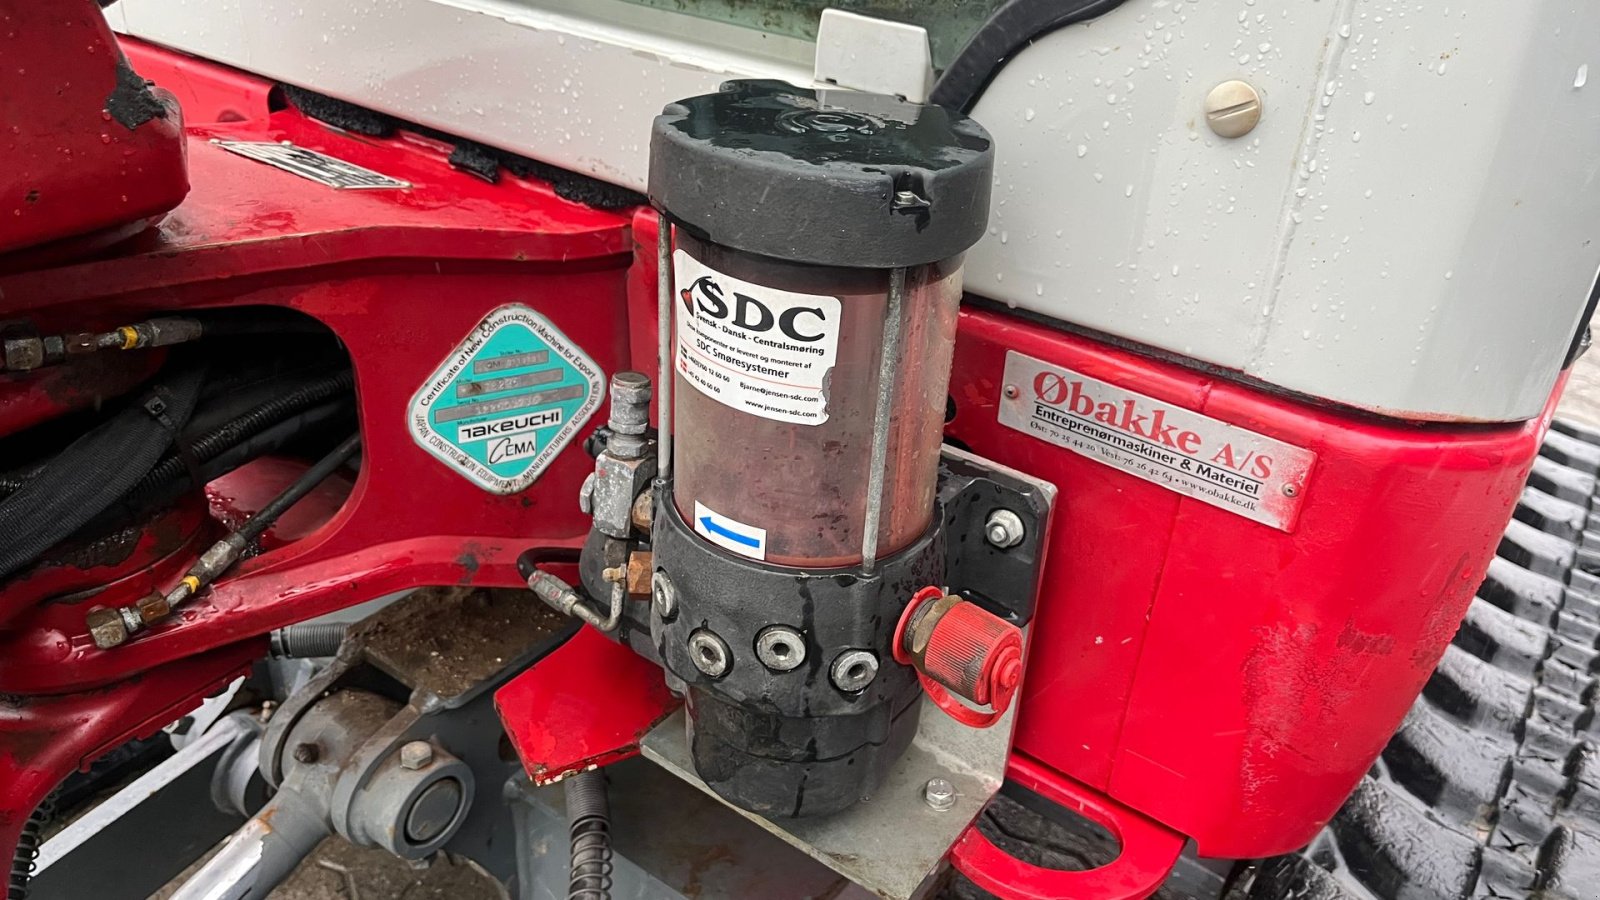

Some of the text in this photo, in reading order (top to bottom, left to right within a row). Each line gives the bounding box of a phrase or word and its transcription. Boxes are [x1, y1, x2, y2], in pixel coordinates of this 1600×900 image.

[697, 276, 826, 342] SDC
[696, 311, 717, 329] Svensk
[722, 325, 747, 340] Dansk
[753, 336, 825, 356] Centralsmøring
[696, 327, 728, 349] komponenter
[736, 348, 759, 359] leveret
[760, 355, 769, 363] og
[770, 357, 802, 368] monteret
[421, 365, 460, 406] Certificate
[458, 354, 468, 366] of
[464, 337, 483, 357] New
[482, 314, 538, 338] Construction
[537, 325, 565, 352] Machine
[563, 348, 575, 360] for
[573, 356, 597, 379] Export
[696, 338, 790, 378] SDC Smøresystemer
[708, 367, 714, 375] 12
[739, 382, 819, 402] Bjarne@jensen-sdc.com
[745, 400, 818, 418] www.jensen-sdc.com
[415, 414, 430, 438] JAPAN
[477, 468, 517, 489] EQUIPMENT
[522, 426, 572, 480] MANUFACTURERS
[571, 381, 600, 427] ASSOCIATION
[1033, 371, 1273, 479] Øbakke A/S
[488, 437, 535, 464] CEMA
[1030, 421, 1047, 433] Øst:
[1072, 440, 1083, 448] 44
[1101, 447, 1121, 460] Vest:
[1123, 458, 1134, 466] 76
[1148, 468, 1159, 476] 42
[1162, 472, 1173, 482] 64
[1182, 479, 1257, 512] www.obakke.dk
[1035, 405, 1259, 495] Entreprenørmaskiner & Materiel
